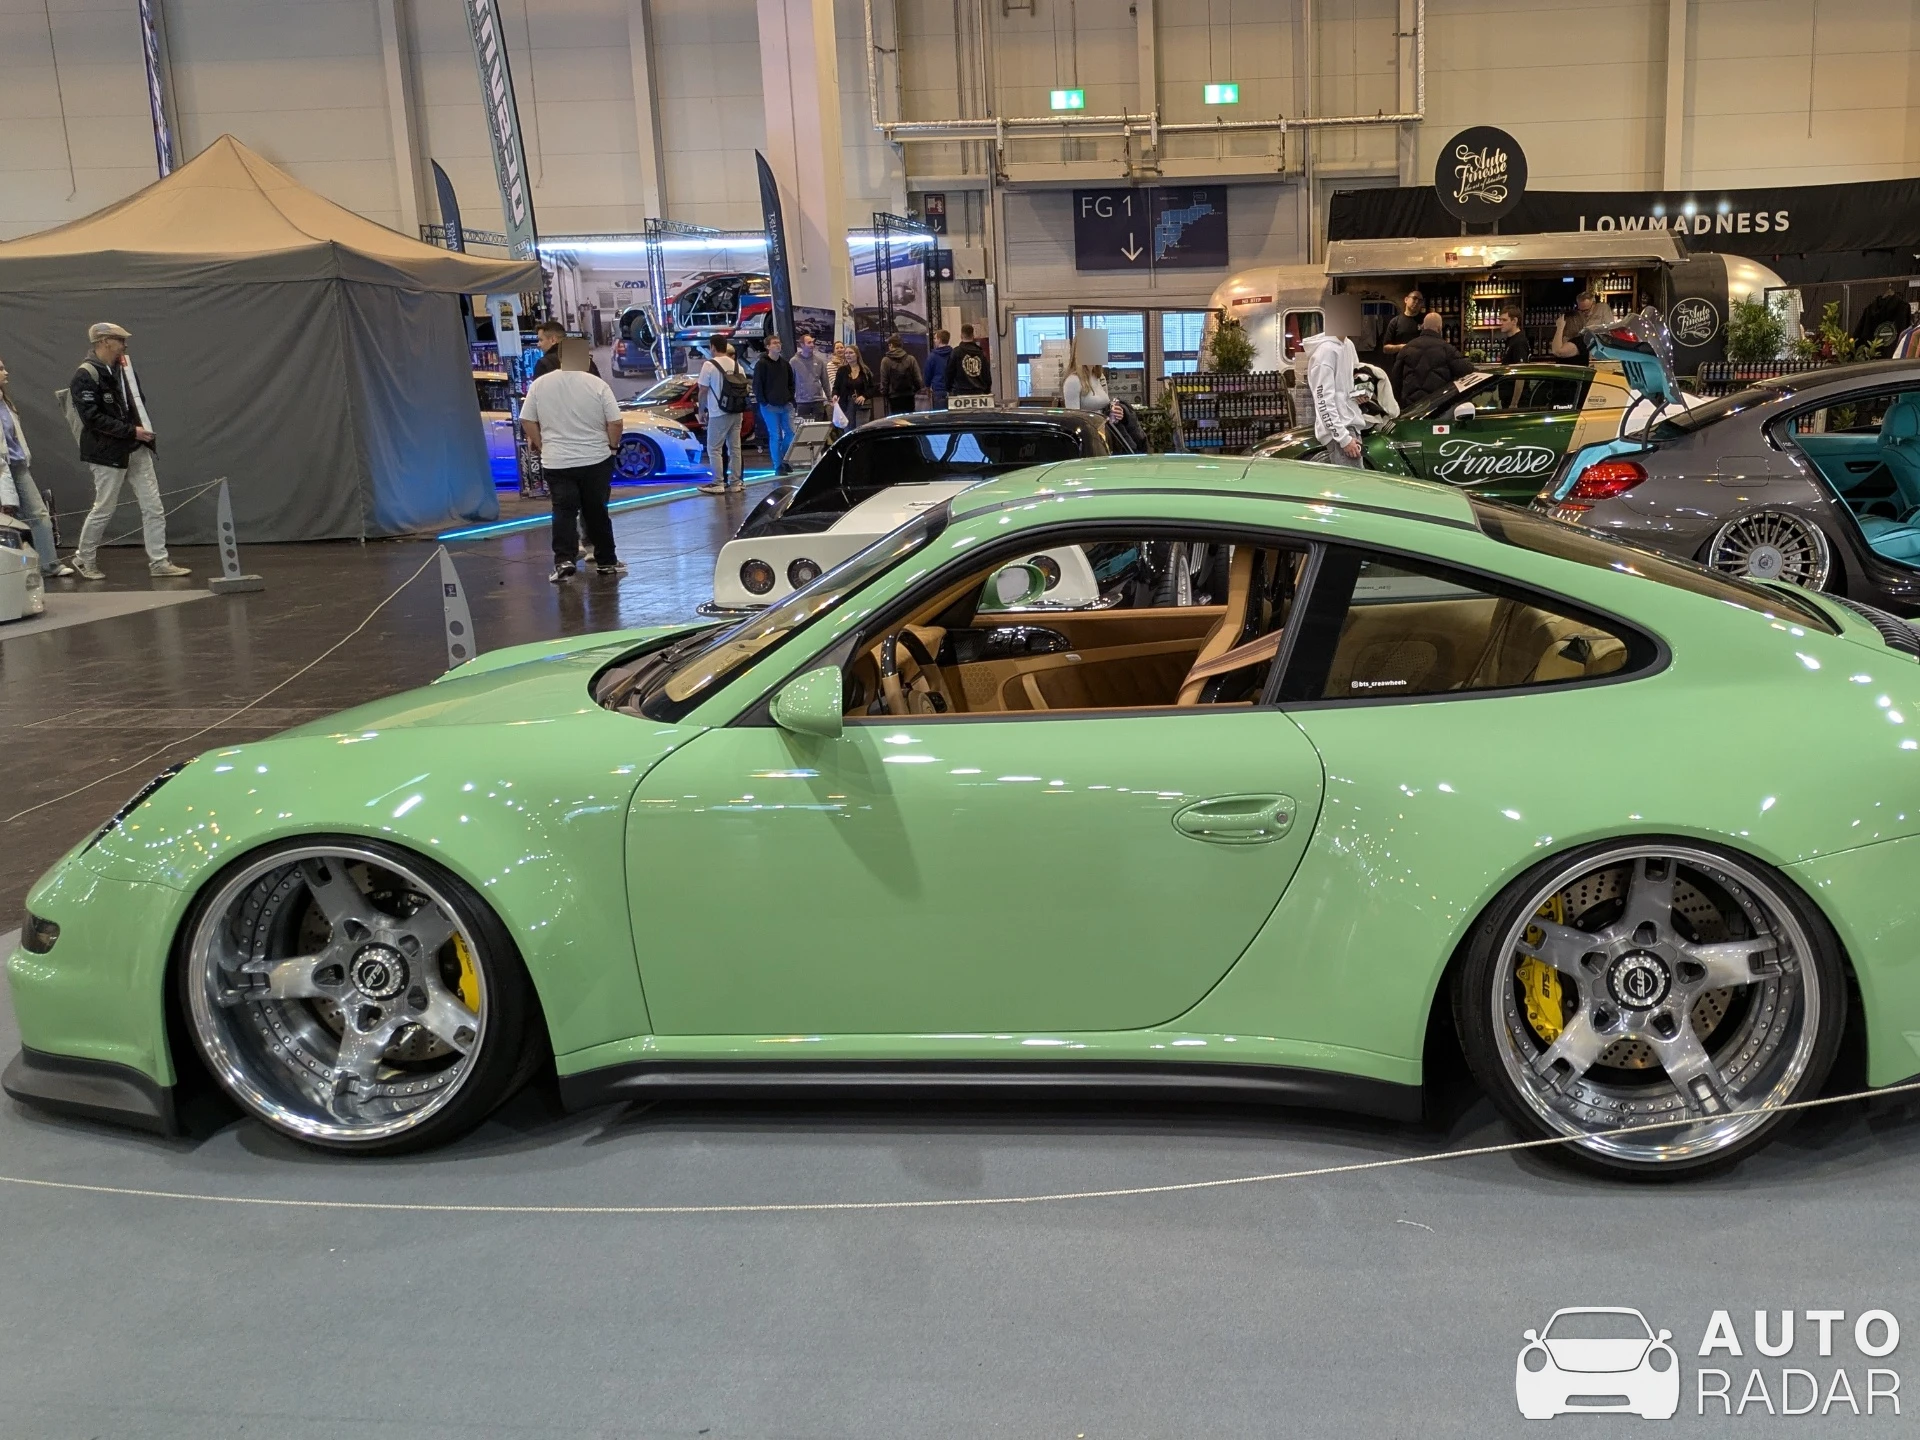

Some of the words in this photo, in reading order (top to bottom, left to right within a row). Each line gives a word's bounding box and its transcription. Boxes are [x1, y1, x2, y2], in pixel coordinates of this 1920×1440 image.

[1456, 144, 1508, 169] Auto
[1453, 161, 1508, 198] Finesse
[1081, 196, 1113, 219] FG
[1122, 194, 1132, 217] 1
[1579, 210, 1790, 235] LOWMADNESS
[953, 398, 988, 408] OPEN
[1316, 384, 1324, 399] The
[1318, 399, 1328, 413] 911
[1322, 413, 1334, 428] GT3
[1434, 439, 1556, 486] Finesse
